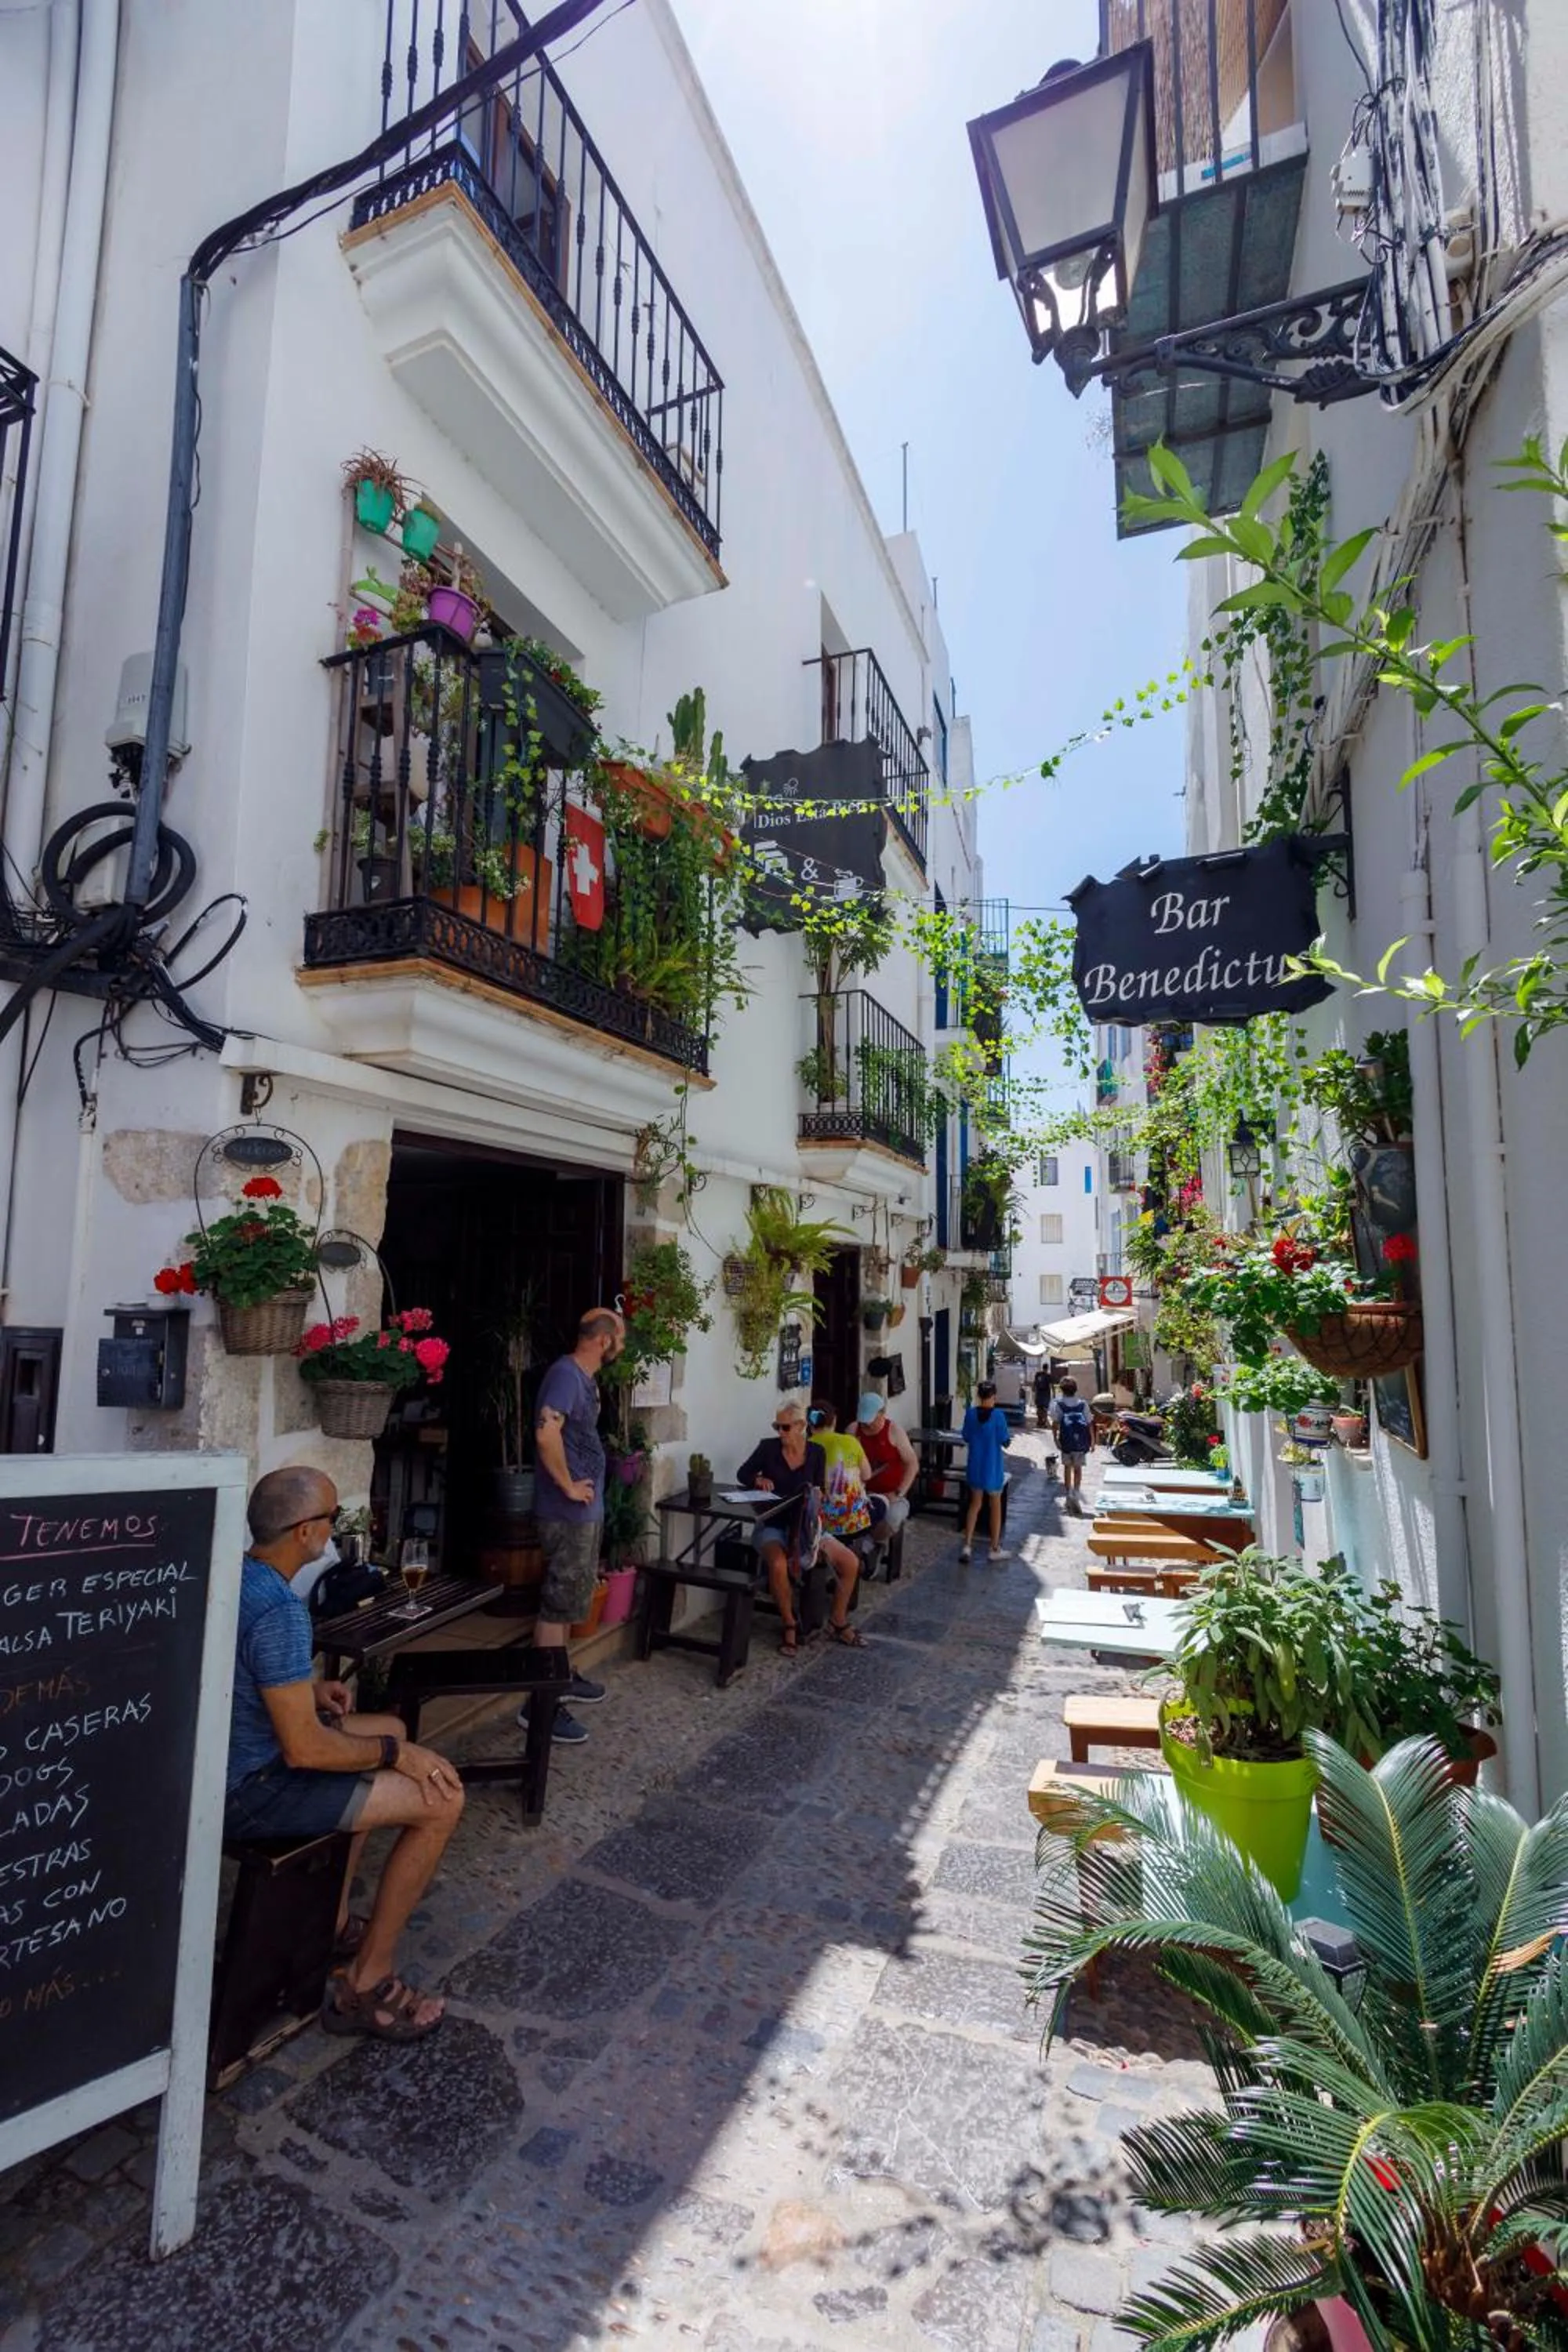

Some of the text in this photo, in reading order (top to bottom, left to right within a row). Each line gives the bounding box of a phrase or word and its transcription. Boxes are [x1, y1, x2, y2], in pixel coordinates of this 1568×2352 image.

[758, 812, 790, 829] Dios
[800, 857, 818, 881] &
[1151, 892, 1230, 934] Bar
[10, 1514, 158, 1548] TENEMOS
[82, 1561, 198, 1594] ESPECIAL
[56, 1586, 176, 1640] TERIYAKI
[25, 1693, 151, 1751] CASERAS
[43, 1869, 102, 1908] CON
